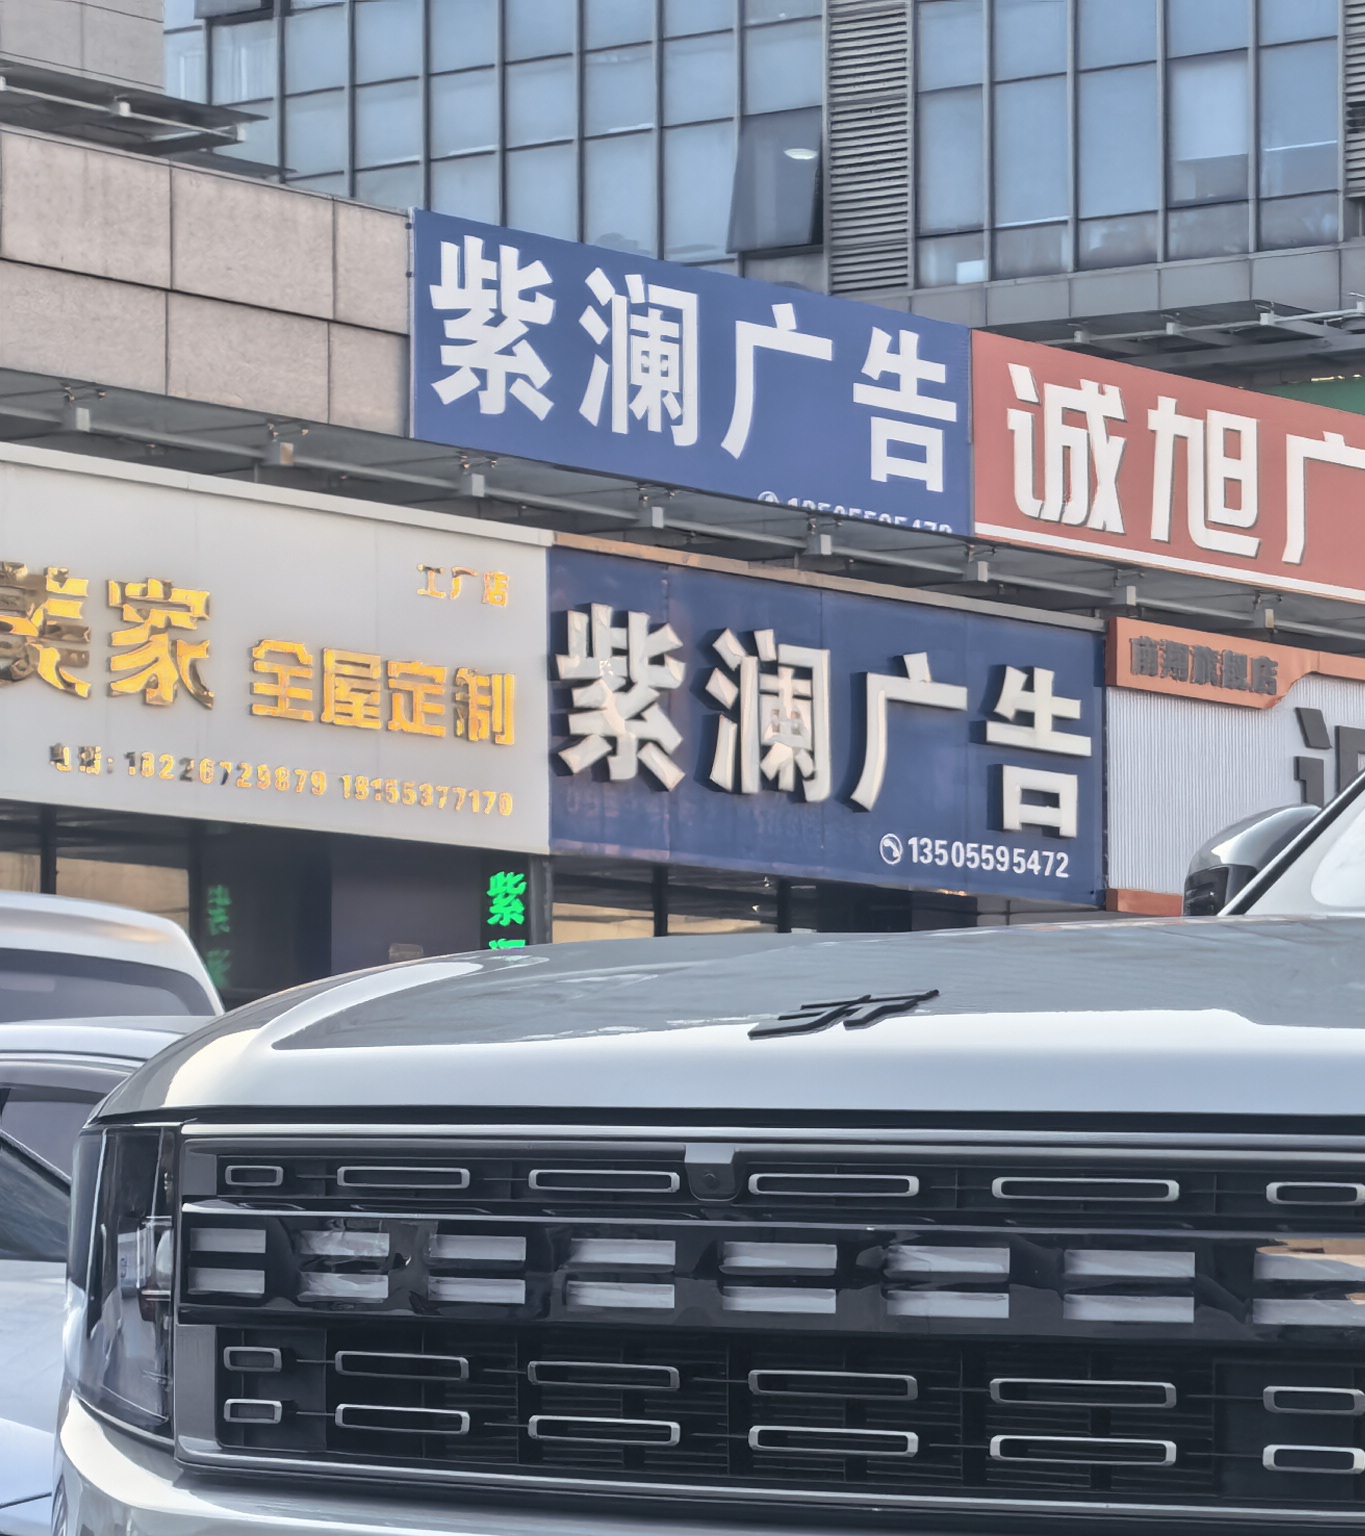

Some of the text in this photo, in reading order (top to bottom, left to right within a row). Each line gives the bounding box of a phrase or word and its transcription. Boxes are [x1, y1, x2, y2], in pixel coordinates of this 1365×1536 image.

[429, 235, 958, 492] 紫澜广告
[251, 638, 516, 746] 全屋定制
[556, 602, 1092, 838] 紫澜广告
[487, 871, 527, 951] 紫
[907, 836, 1070, 879] 13505595472
